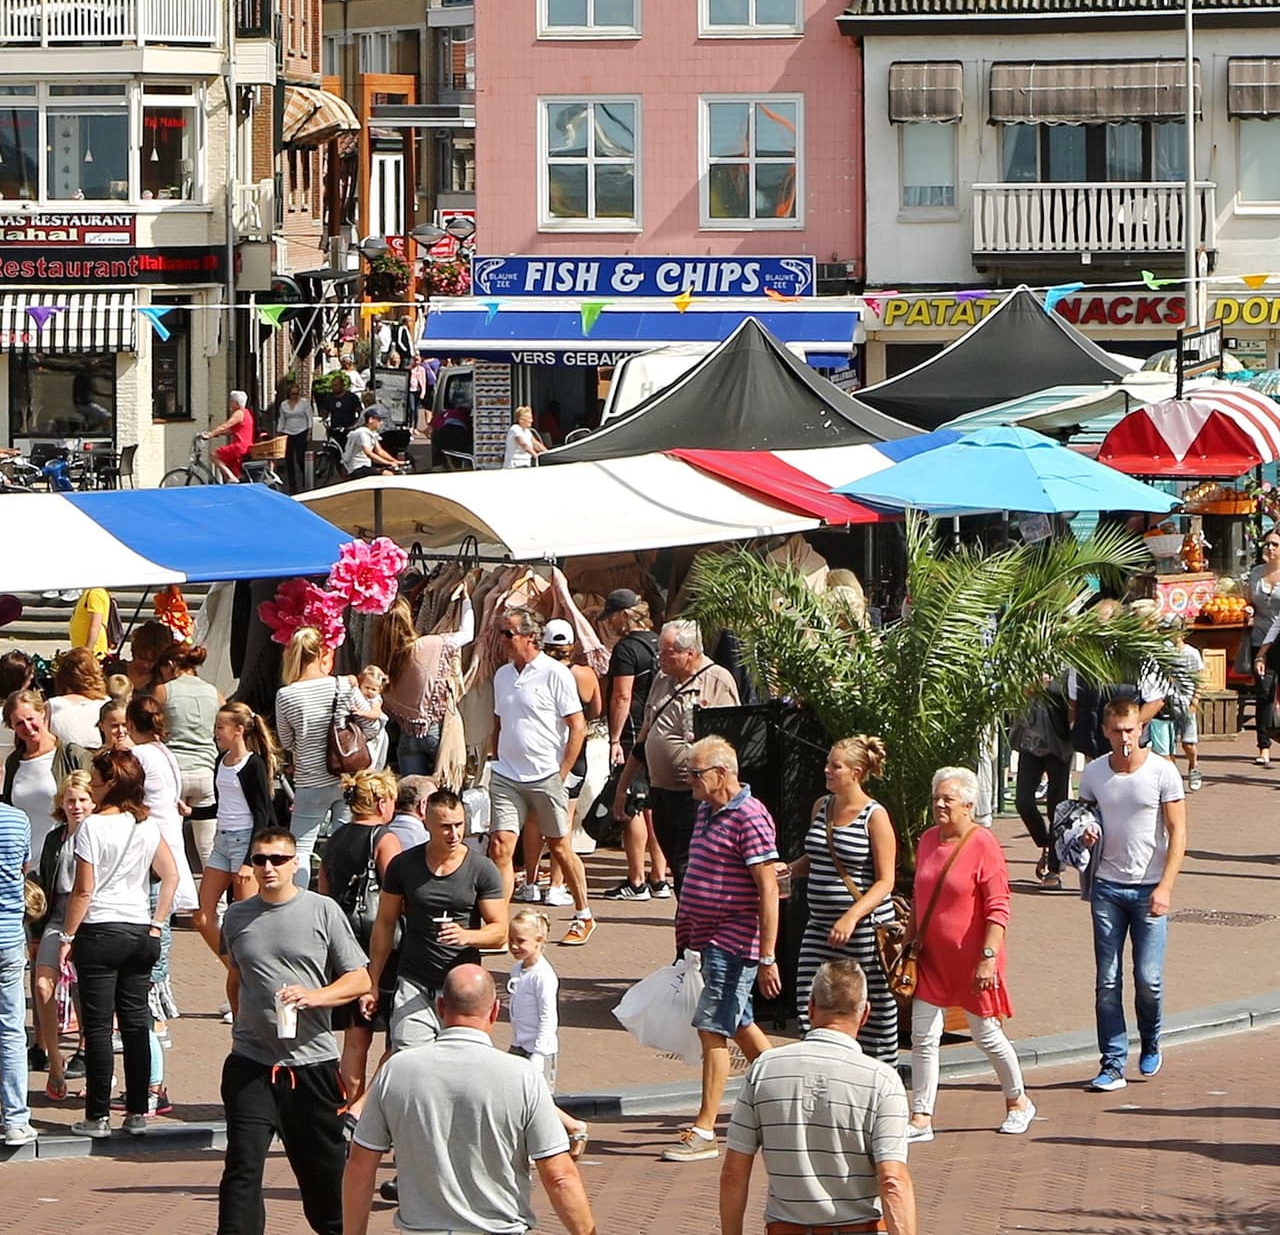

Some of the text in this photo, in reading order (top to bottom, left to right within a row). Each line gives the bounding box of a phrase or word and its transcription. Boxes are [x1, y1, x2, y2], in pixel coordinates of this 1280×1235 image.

[30, 215, 133, 226] RESTAURANT
[489, 272, 518, 281] BLAUWE
[524, 262, 760, 293] FISH & CHIPS
[773, 281, 788, 289] ZEE
[884, 298, 1000, 326] PATAT
[1055, 297, 1186, 325] NACKS
[511, 351, 636, 366] VERS GEBAK
